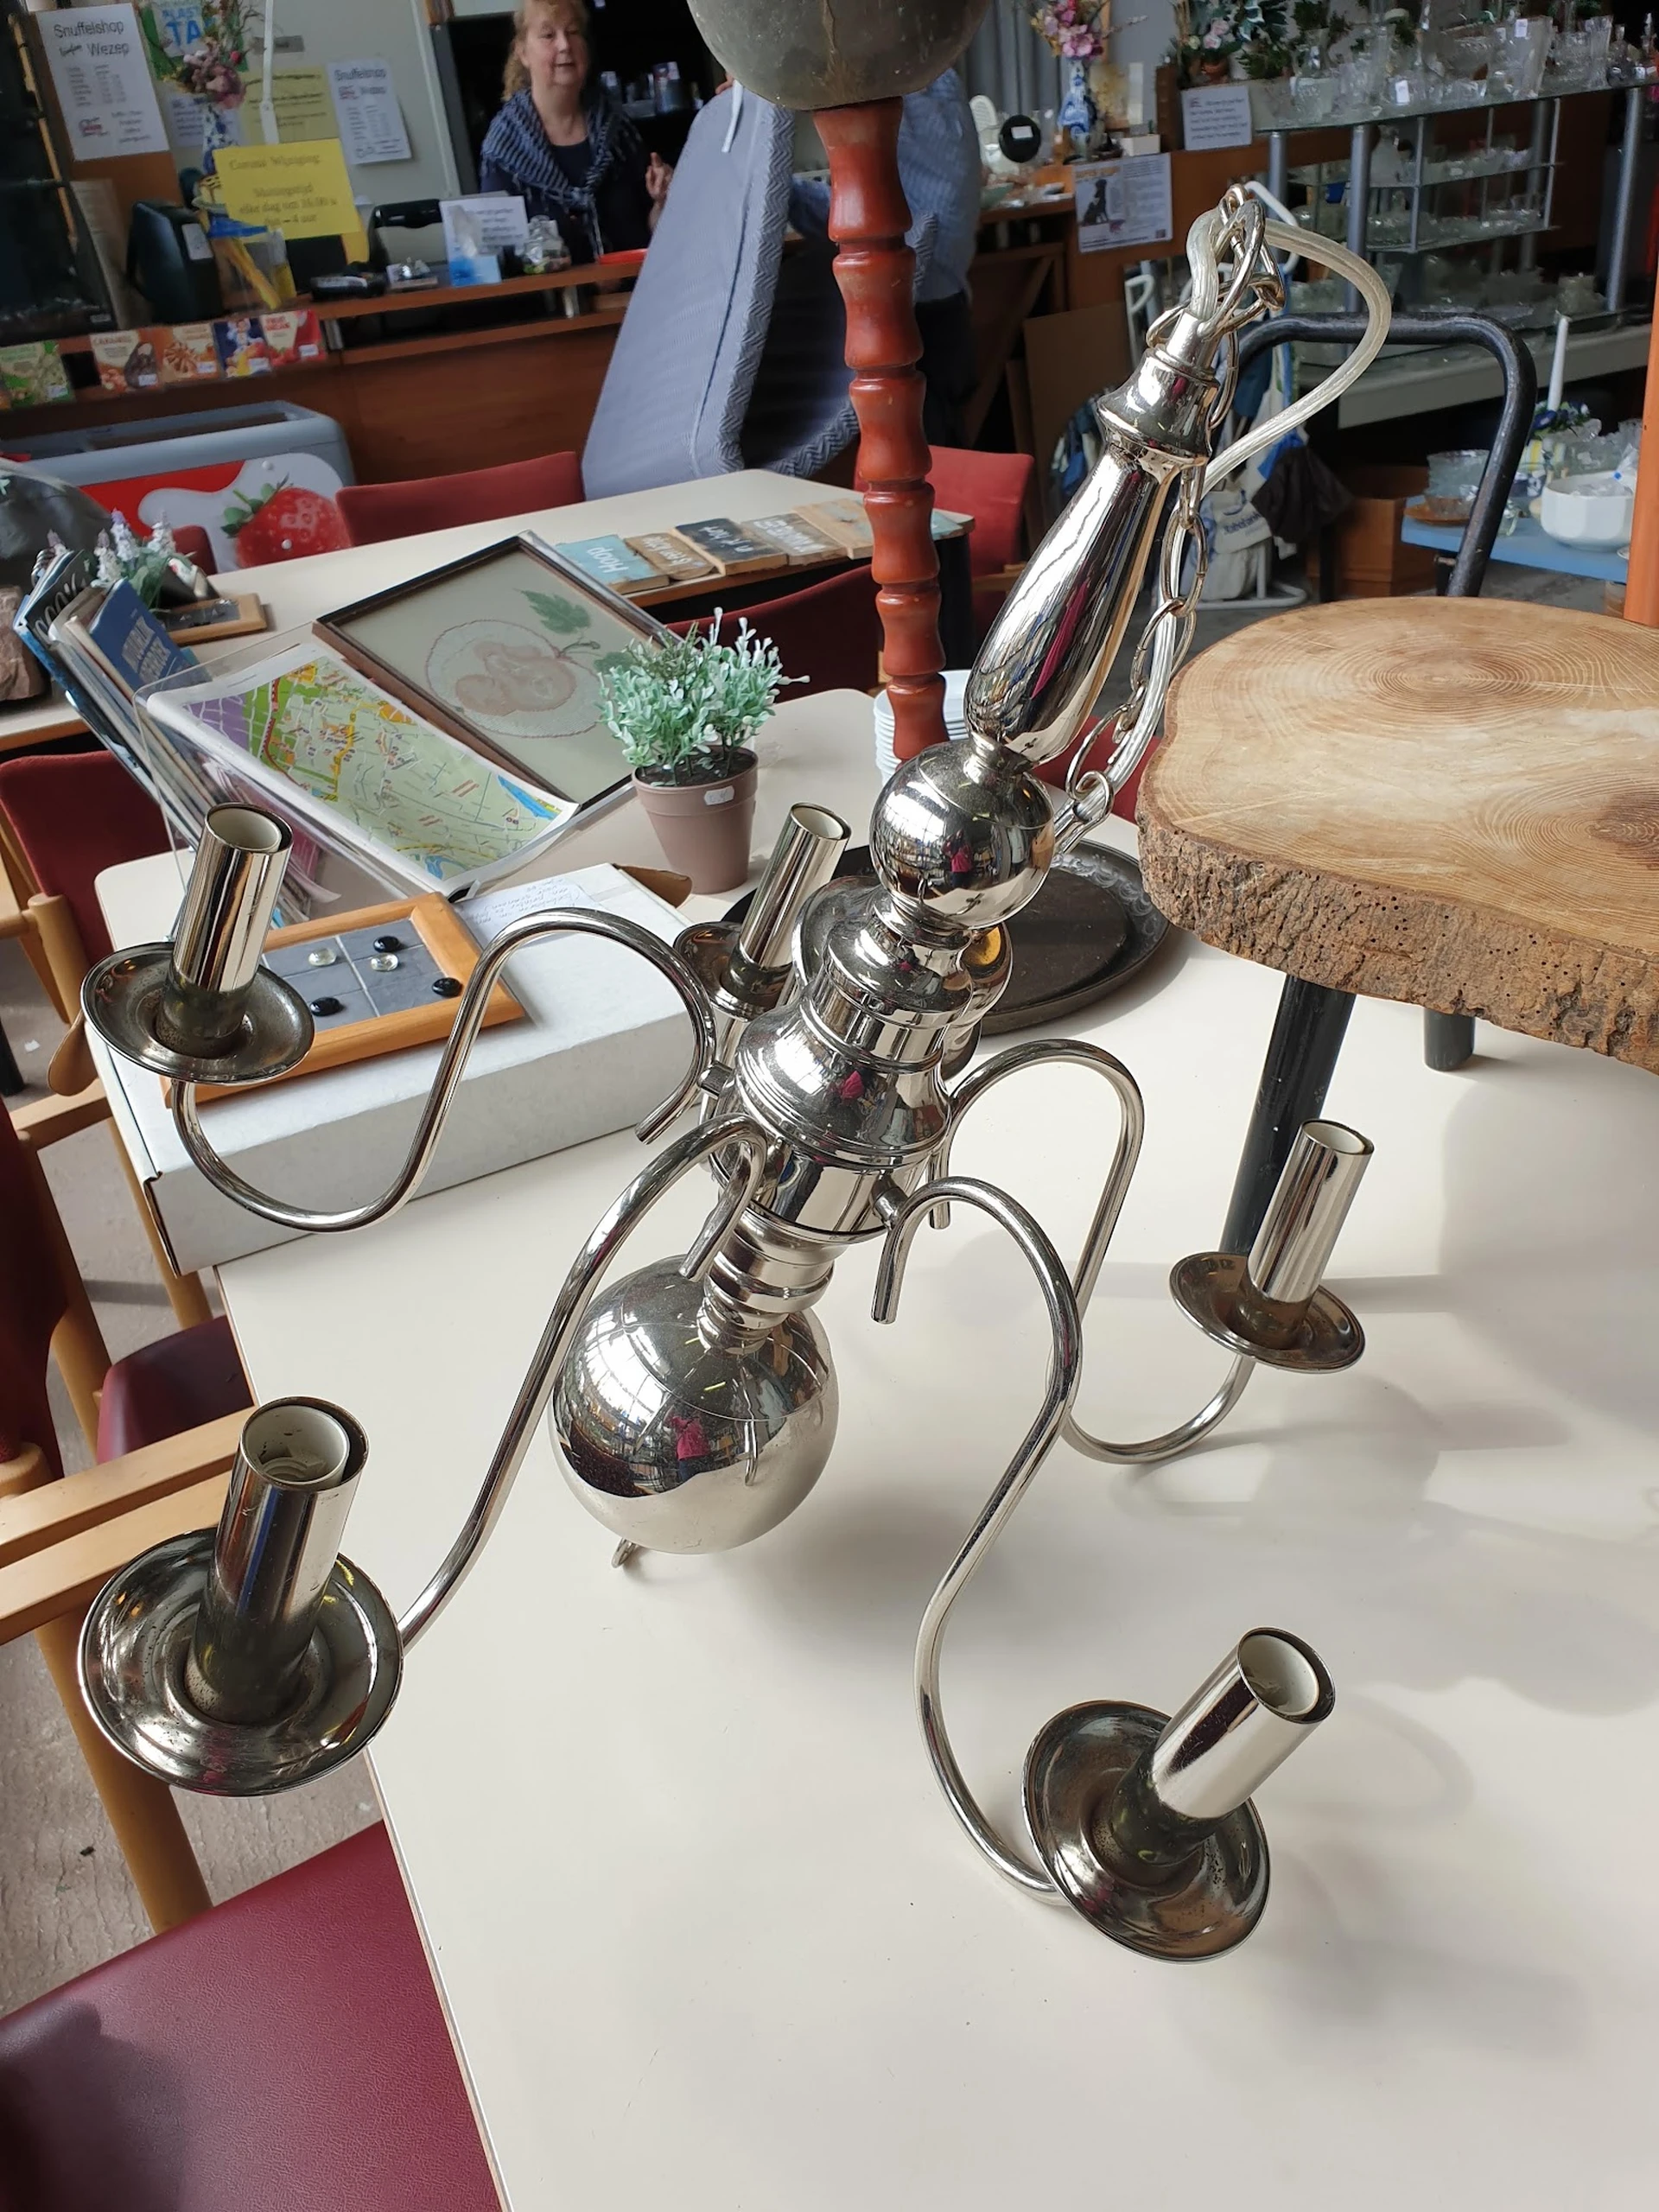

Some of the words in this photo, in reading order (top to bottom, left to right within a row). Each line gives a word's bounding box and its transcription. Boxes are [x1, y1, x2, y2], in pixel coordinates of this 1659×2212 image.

[54, 20, 124, 39] Snuffelshop
[87, 42, 130, 57] Wezep
[588, 547, 629, 574] Hoop
